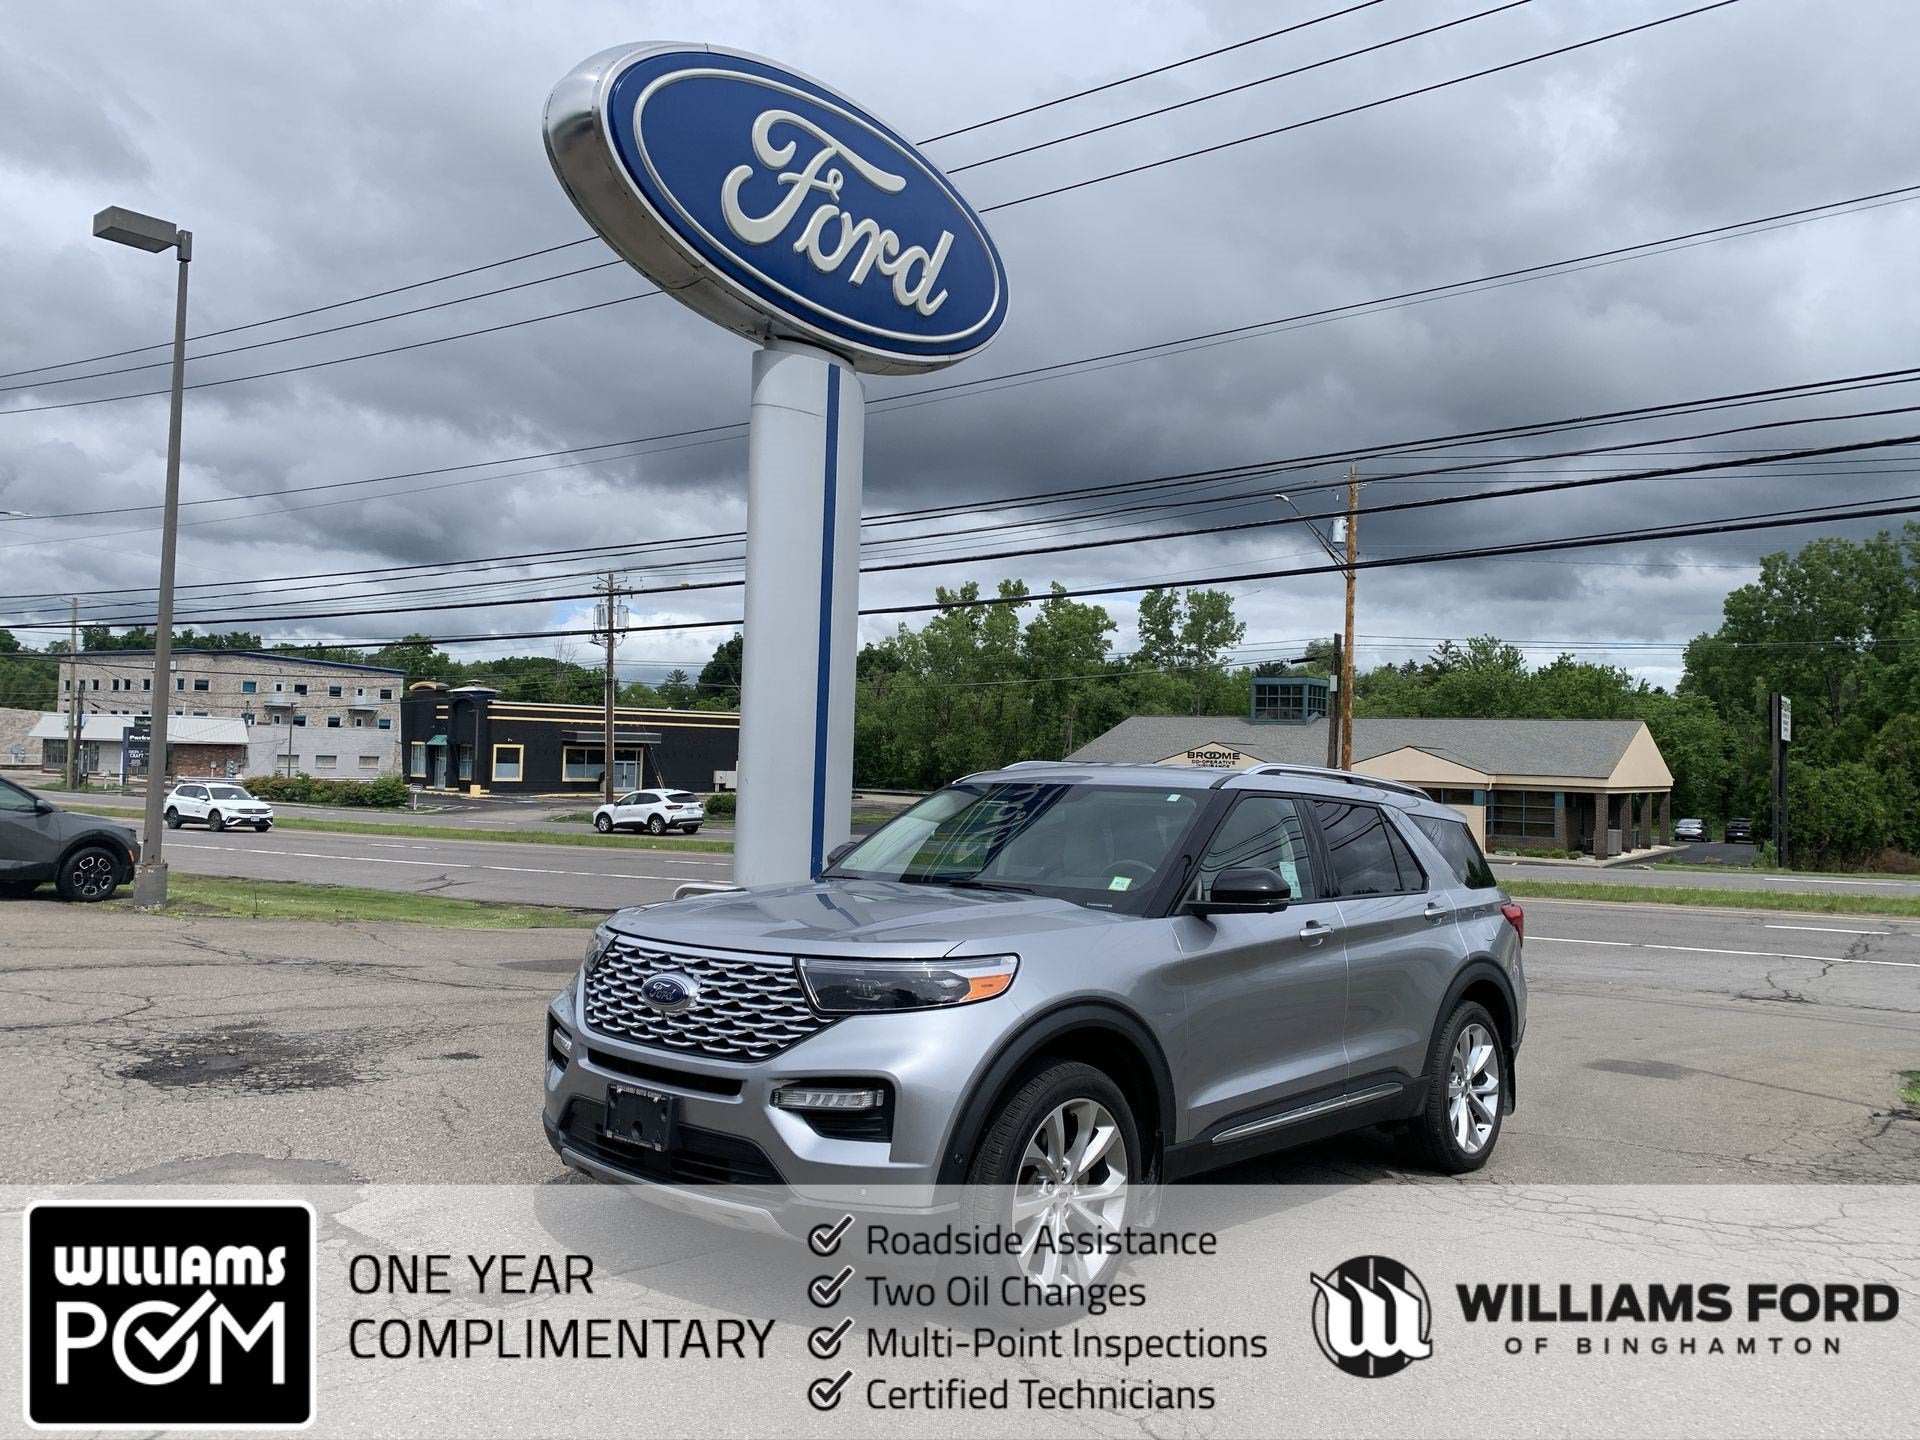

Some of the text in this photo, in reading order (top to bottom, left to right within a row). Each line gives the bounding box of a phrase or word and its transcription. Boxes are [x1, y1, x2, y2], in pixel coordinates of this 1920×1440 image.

[721, 109, 955, 316] Ford
[1187, 751, 1241, 760] BROOME
[650, 981, 677, 1001] Ford
